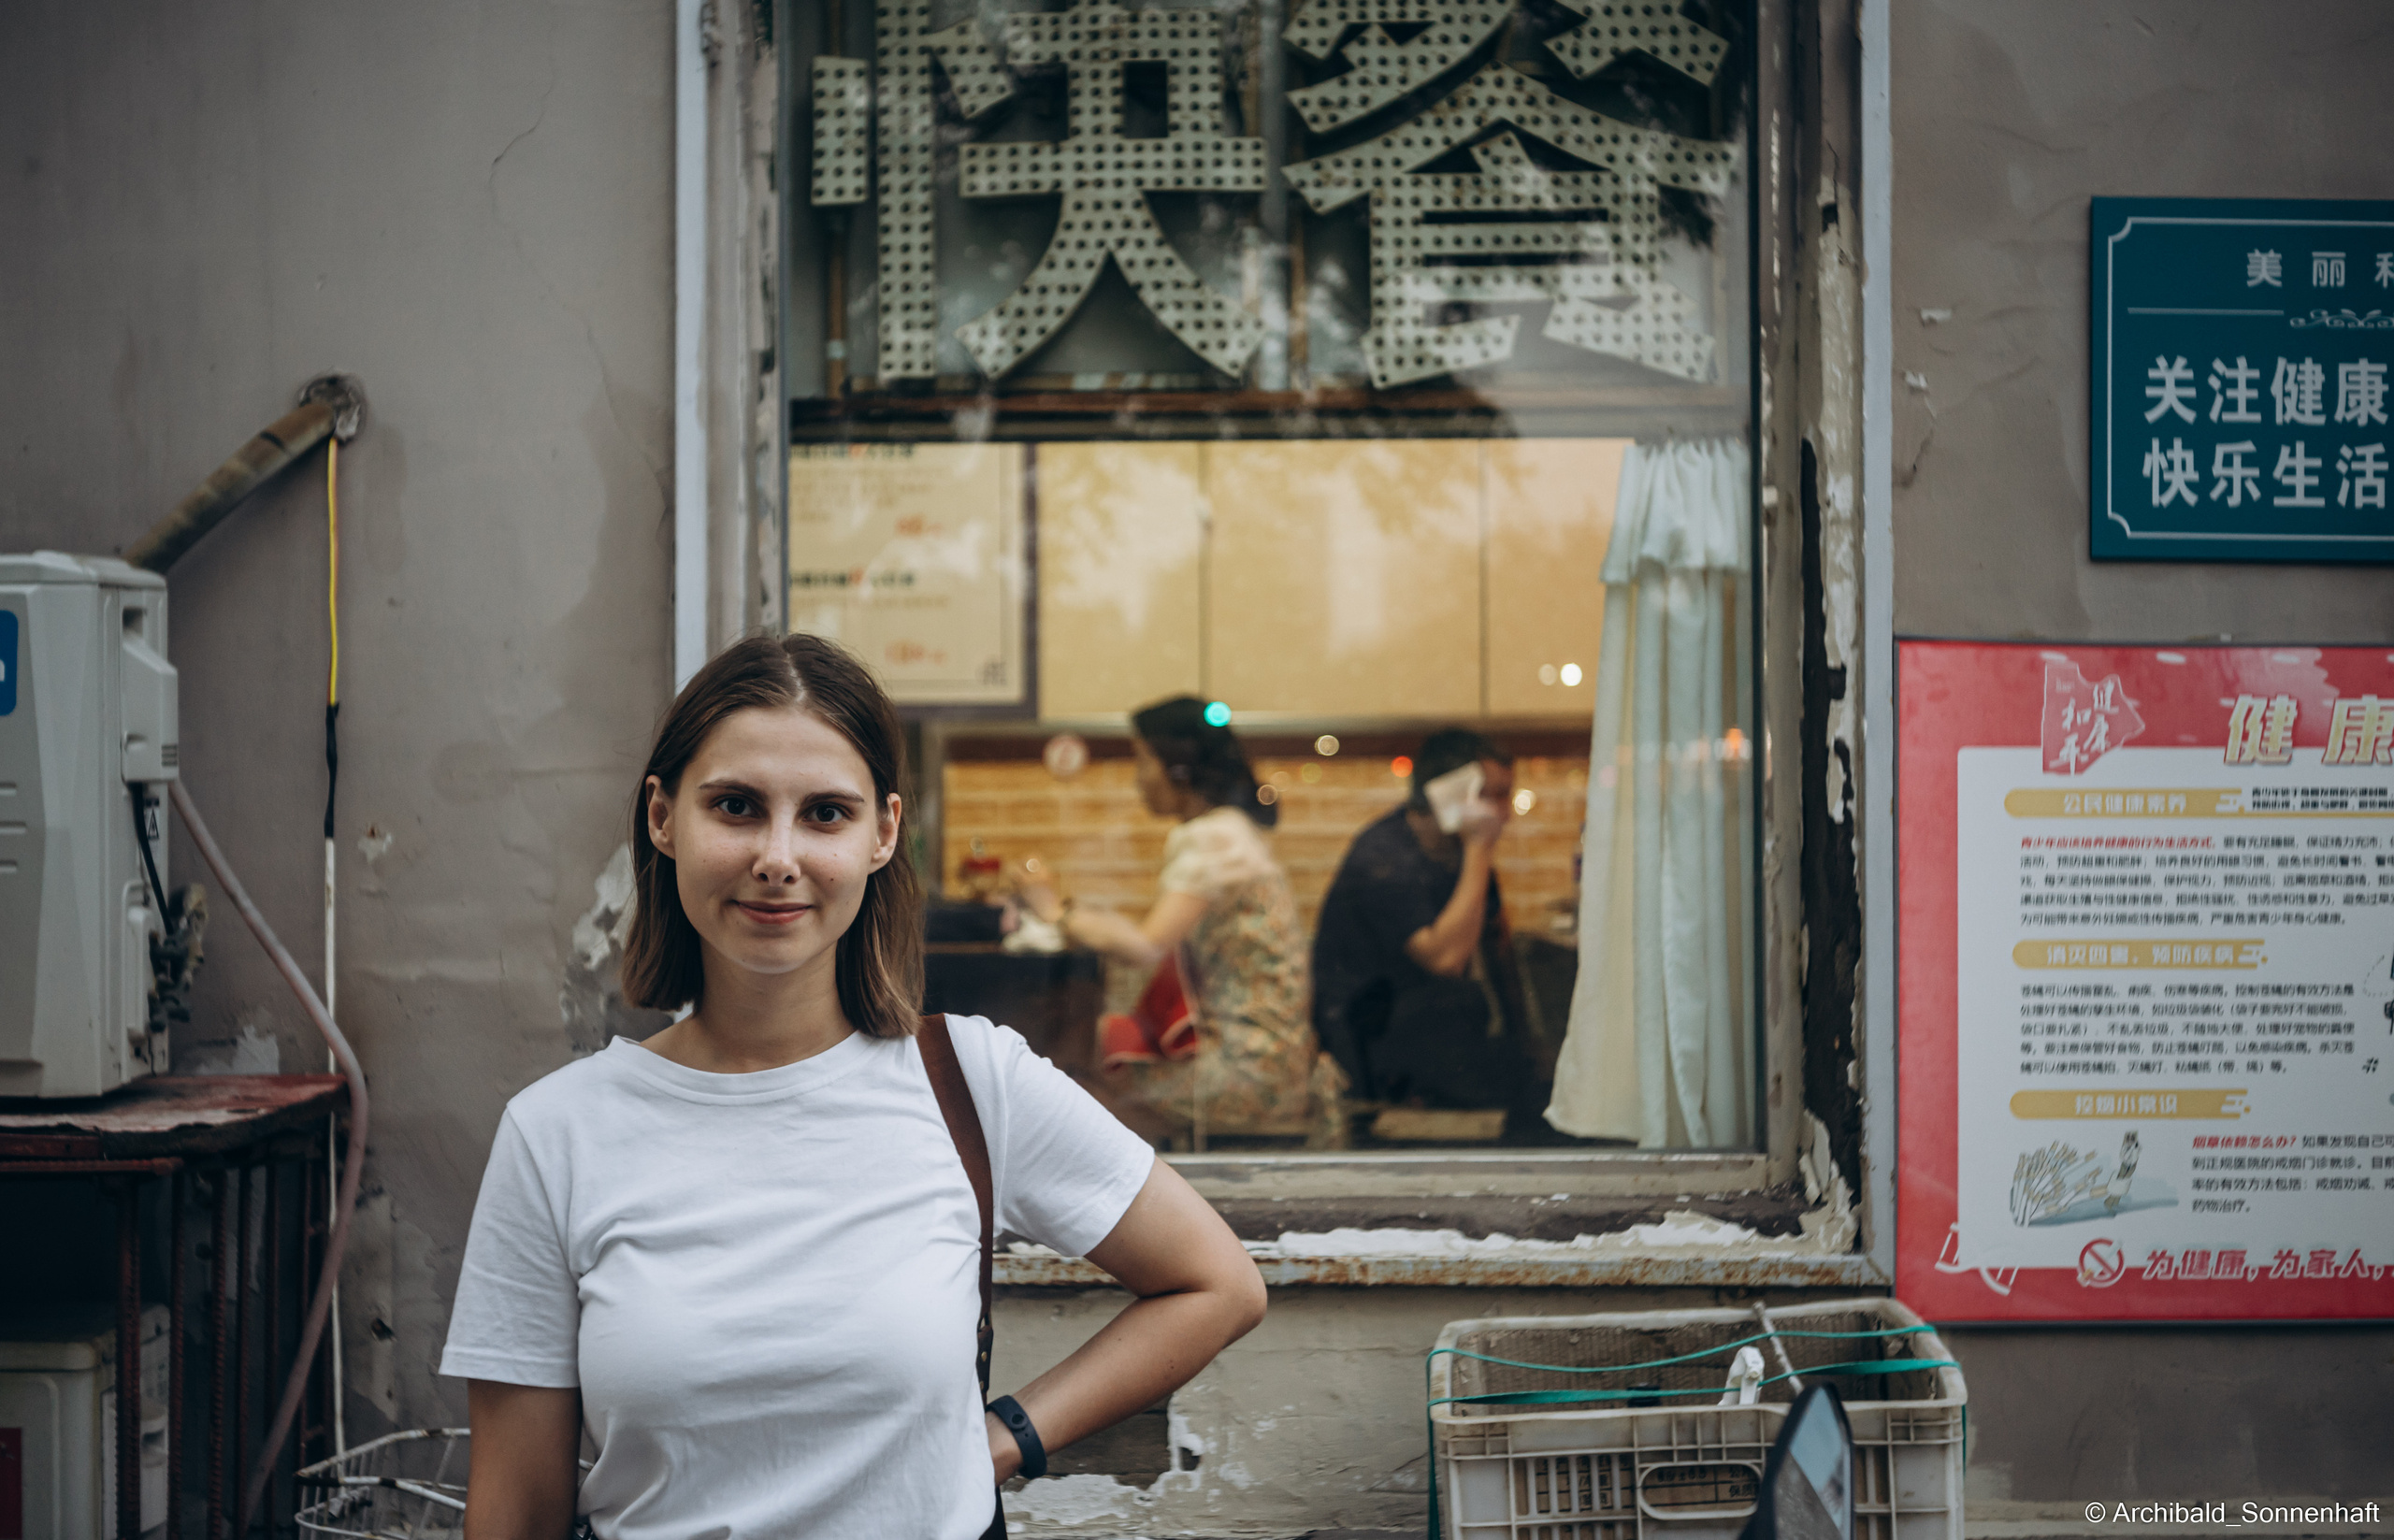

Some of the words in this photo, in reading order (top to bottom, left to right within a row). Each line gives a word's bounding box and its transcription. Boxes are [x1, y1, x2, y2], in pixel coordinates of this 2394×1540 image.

[813, 0, 1737, 388] 快餐
[2143, 354, 2389, 426] 关注健康
[2142, 437, 2389, 509] 快乐生活
[2224, 694, 2394, 765] 健康
[2063, 792, 2187, 814] 公民健康素养
[2075, 1094, 2177, 1115] 控烟小常识
[2142, 1248, 2394, 1282] 为健康，为家人，
